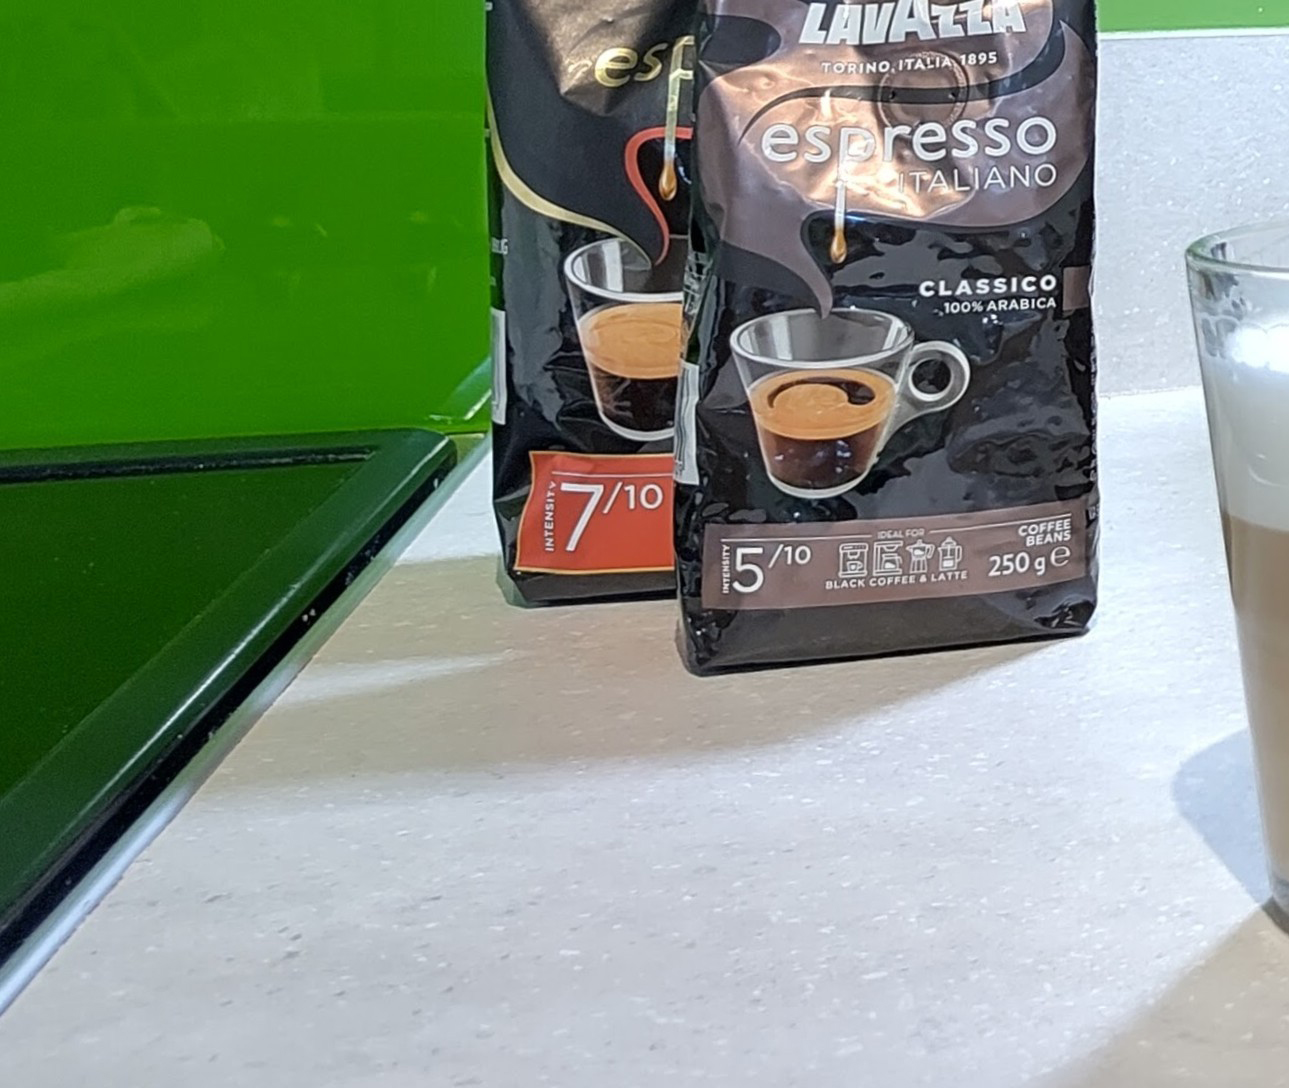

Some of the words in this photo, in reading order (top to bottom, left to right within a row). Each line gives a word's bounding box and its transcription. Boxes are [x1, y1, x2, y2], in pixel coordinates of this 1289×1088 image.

[960, 50, 998, 66] 1895
[760, 115, 1058, 184] espresso
[897, 162, 1058, 195] ITALIANO
[918, 273, 1058, 298] CLASSICO
[943, 300, 984, 315] 100%
[986, 296, 1058, 313] ARABICA
[543, 480, 557, 552] INTENSITY
[877, 529, 905, 541] IDEAL
[905, 527, 925, 538] FOR
[1017, 518, 1072, 537] COFFEE
[1025, 530, 1072, 548] BEANS
[720, 543, 732, 595] INTENSITY
[825, 578, 866, 591] BLACK
[868, 575, 917, 588] COFFEE
[930, 570, 968, 583] LATTE
